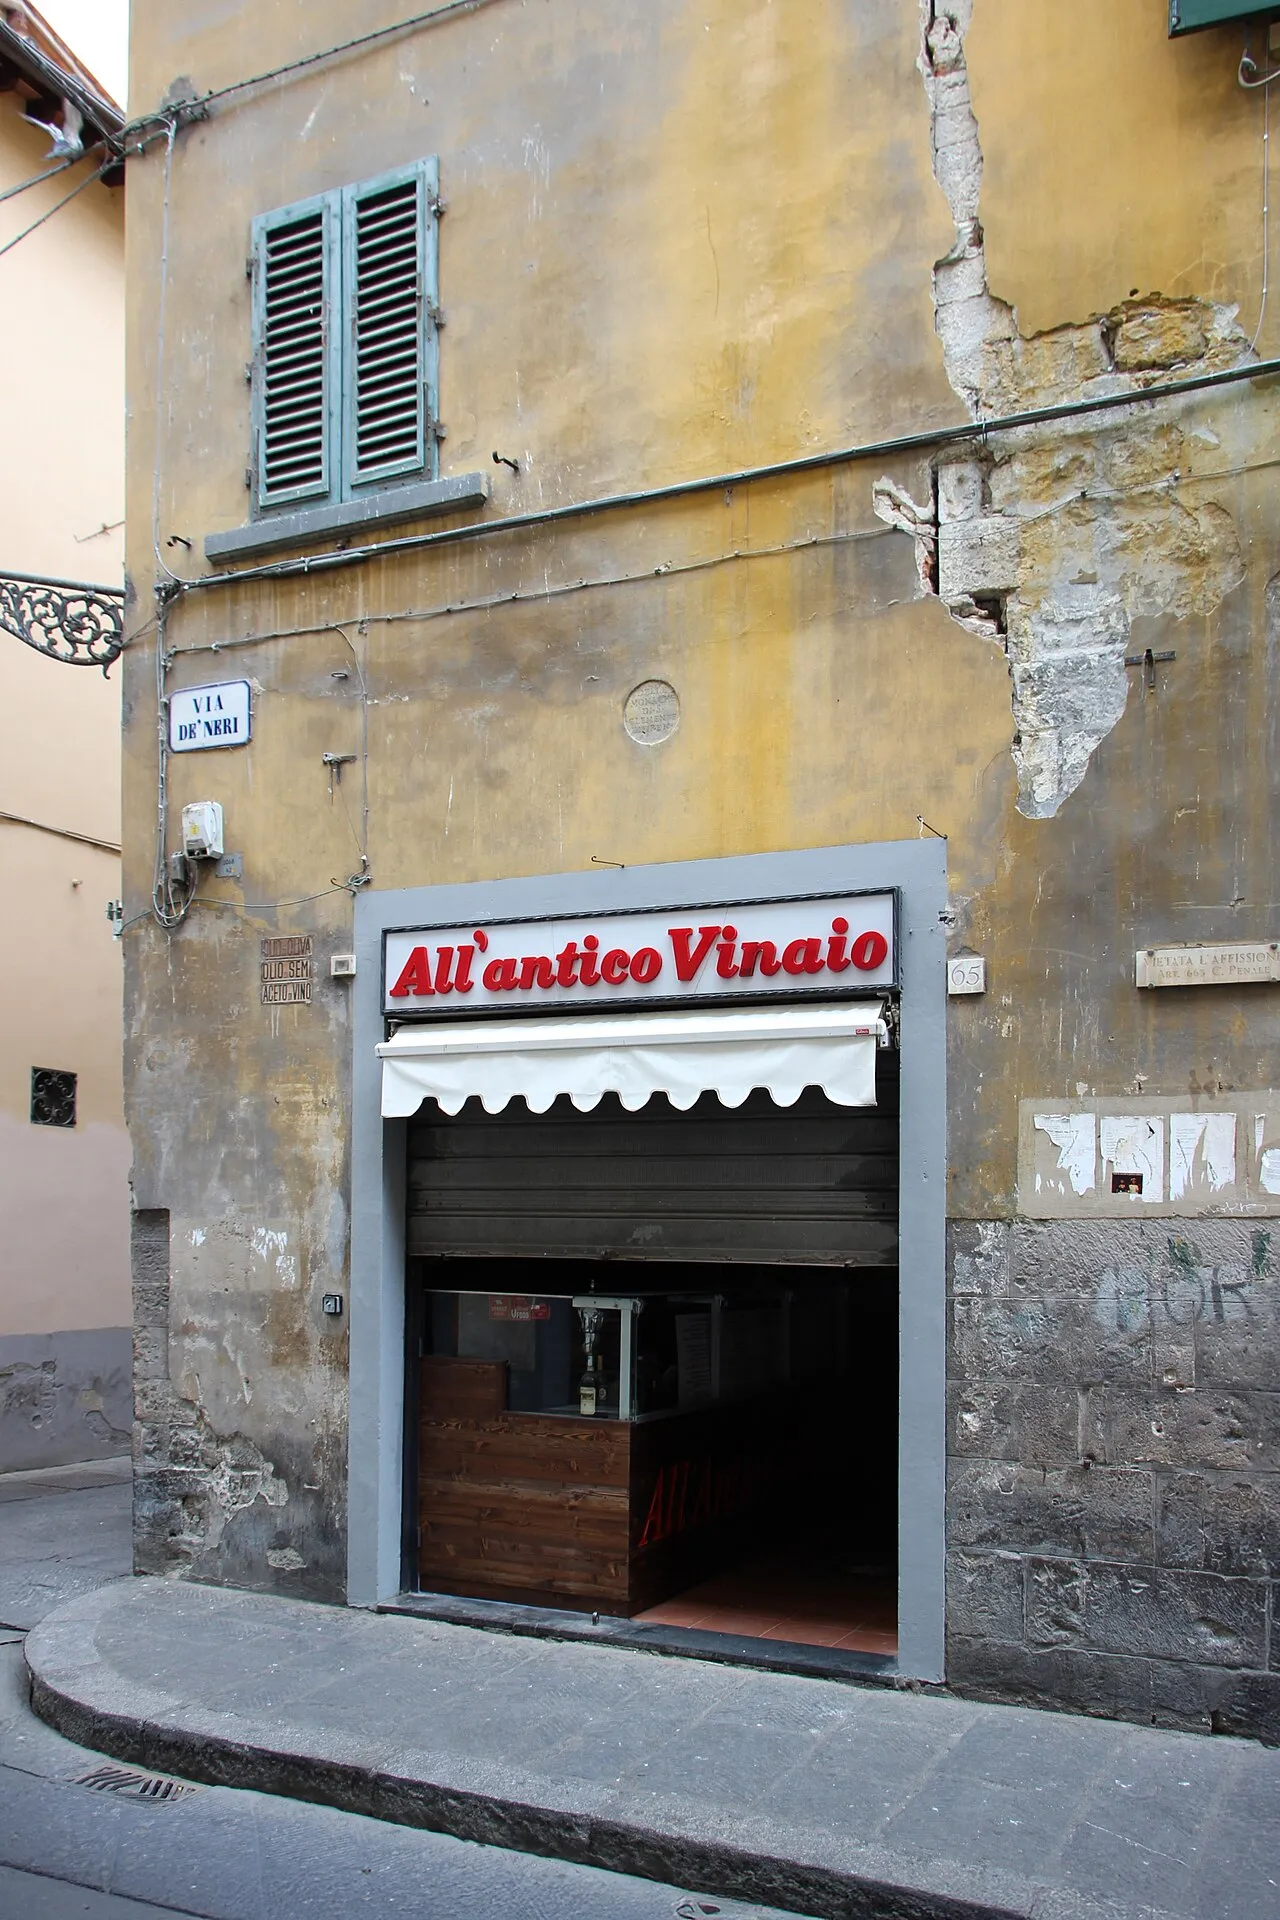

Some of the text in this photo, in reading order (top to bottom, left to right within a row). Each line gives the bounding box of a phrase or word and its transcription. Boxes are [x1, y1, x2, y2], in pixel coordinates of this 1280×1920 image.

[193, 695, 223, 713] VIA
[389, 916, 888, 997] All'antico Vinaio
[1144, 955, 1193, 967] VIETATA
[262, 961, 284, 980] OLIO
[951, 963, 981, 986] 65
[263, 984, 288, 1002] ACETO
[292, 983, 311, 1001] VINO
